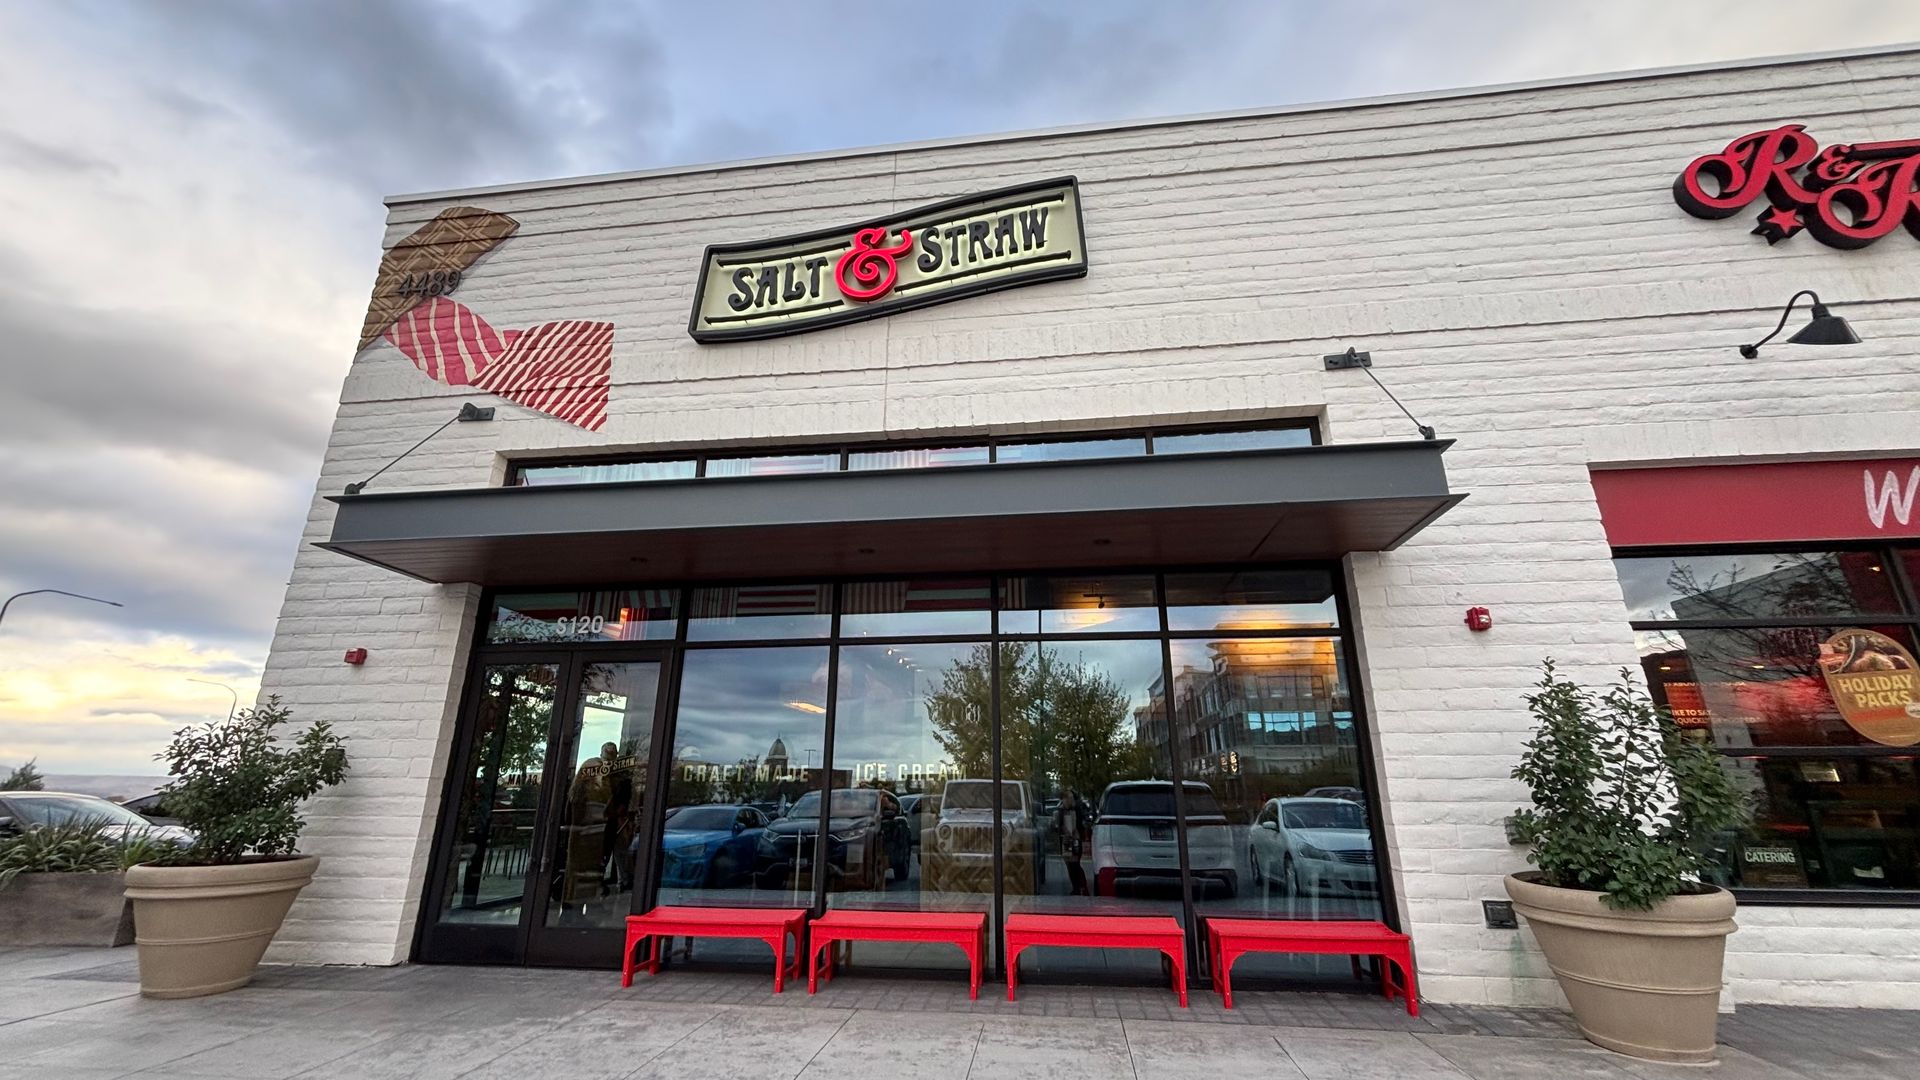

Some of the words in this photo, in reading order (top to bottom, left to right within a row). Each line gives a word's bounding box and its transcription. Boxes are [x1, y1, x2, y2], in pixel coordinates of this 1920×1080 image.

[728, 256, 829, 312] SALT
[834, 227, 914, 302] &
[917, 206, 1049, 273] STRAW
[398, 270, 462, 298] 4489
[556, 615, 604, 635] S120
[1838, 674, 1913, 693] HOLIDAY
[1855, 689, 1913, 708] PACKS
[683, 764, 745, 783] CRAFT
[755, 764, 809, 783] MADE
[855, 762, 888, 782] ICE
[897, 763, 968, 782] CREAM
[1744, 851, 1796, 864] CATERING
